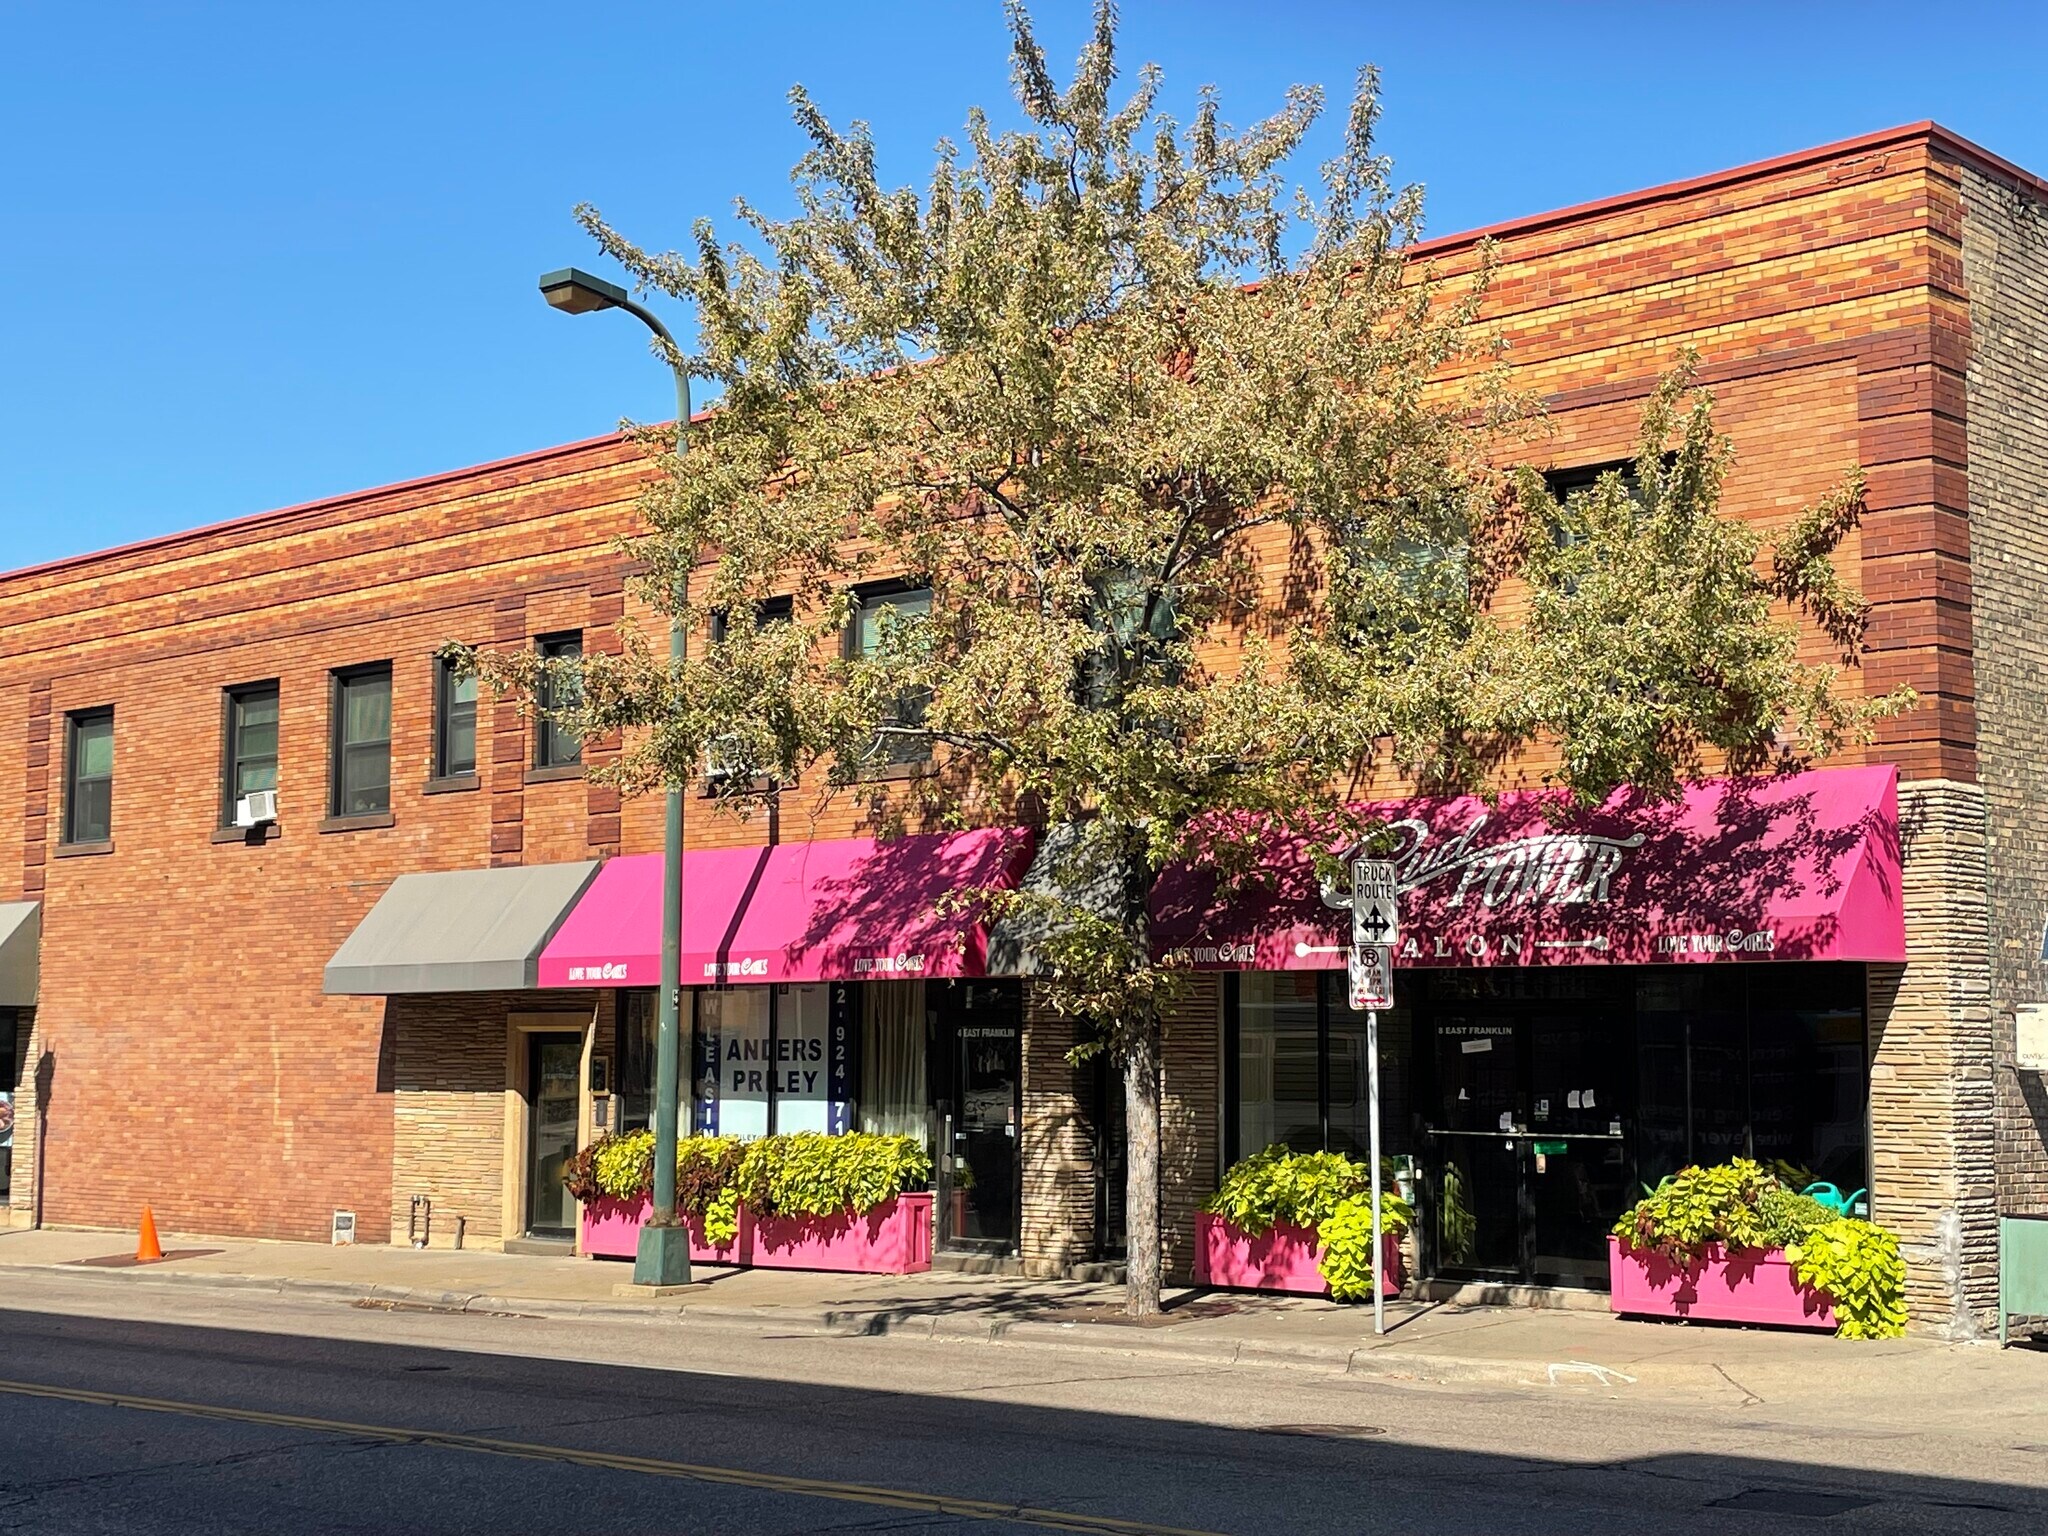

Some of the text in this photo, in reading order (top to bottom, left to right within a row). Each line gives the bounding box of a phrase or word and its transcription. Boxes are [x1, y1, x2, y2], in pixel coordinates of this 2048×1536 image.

[1357, 866, 1392, 882] TRUCK
[1446, 842, 1623, 907] POWER
[1357, 884, 1392, 899] ROUTE
[1400, 934, 1523, 958] ALON
[1658, 936, 1688, 953] LOVE
[1691, 934, 1723, 953] YOUR
[1193, 947, 1218, 962] YOUR
[854, 959, 874, 972] LOVE
[875, 958, 895, 972] YOUR
[963, 1028, 980, 1038] EAST
[981, 1028, 1015, 1038] FRANKLIN
[1445, 1027, 1467, 1035] EAST
[1468, 1027, 1512, 1035] FRANKLIN
[727, 1038, 822, 1061] ANDERS
[834, 982, 846, 1137] 2-924-71
